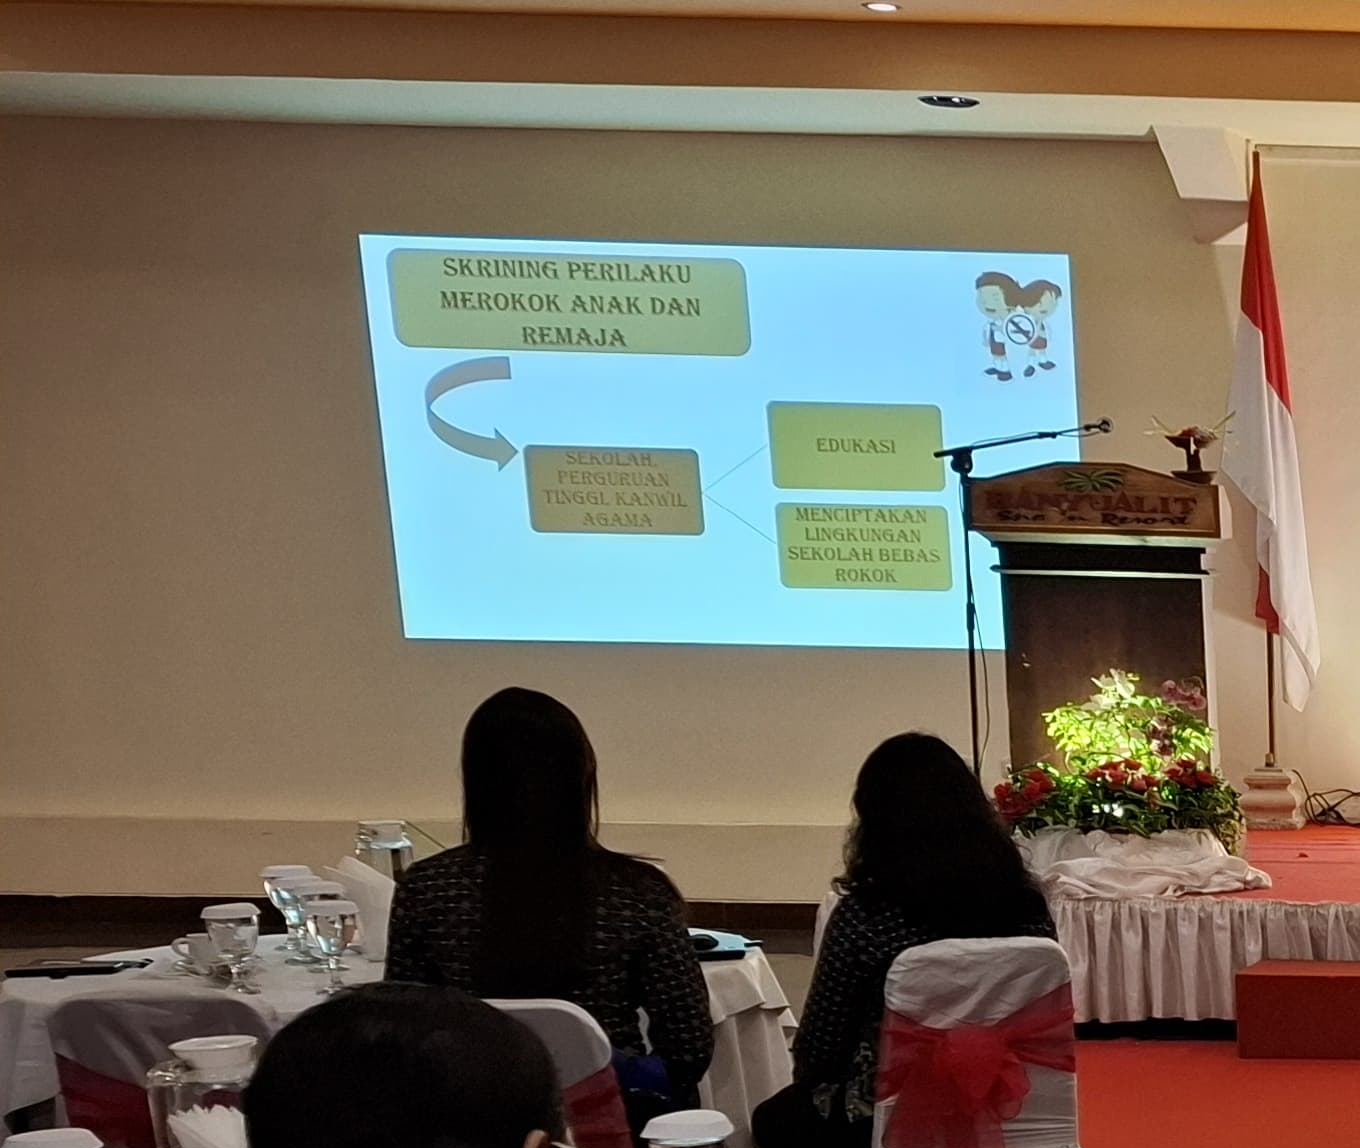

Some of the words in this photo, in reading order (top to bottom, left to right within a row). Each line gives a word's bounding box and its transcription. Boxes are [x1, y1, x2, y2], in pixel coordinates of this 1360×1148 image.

[443, 256, 559, 280] SKRINING
[567, 260, 692, 284] PERILAKU
[440, 290, 562, 313] MEROKOK
[570, 295, 644, 316] ANAK
[650, 296, 701, 317] DAN
[522, 325, 628, 347] REMAJA
[816, 438, 896, 454] EDUKASI
[557, 469, 671, 487] PERGURUAN
[616, 491, 689, 507] KANWIL
[583, 511, 653, 527] AGAMA
[795, 507, 928, 524] MENCIPTAKAN
[805, 527, 922, 543] LINGKUNGAN
[788, 546, 873, 562] SEKOLAH
[879, 548, 941, 563] BEBAS
[835, 568, 897, 583] ROKOK
